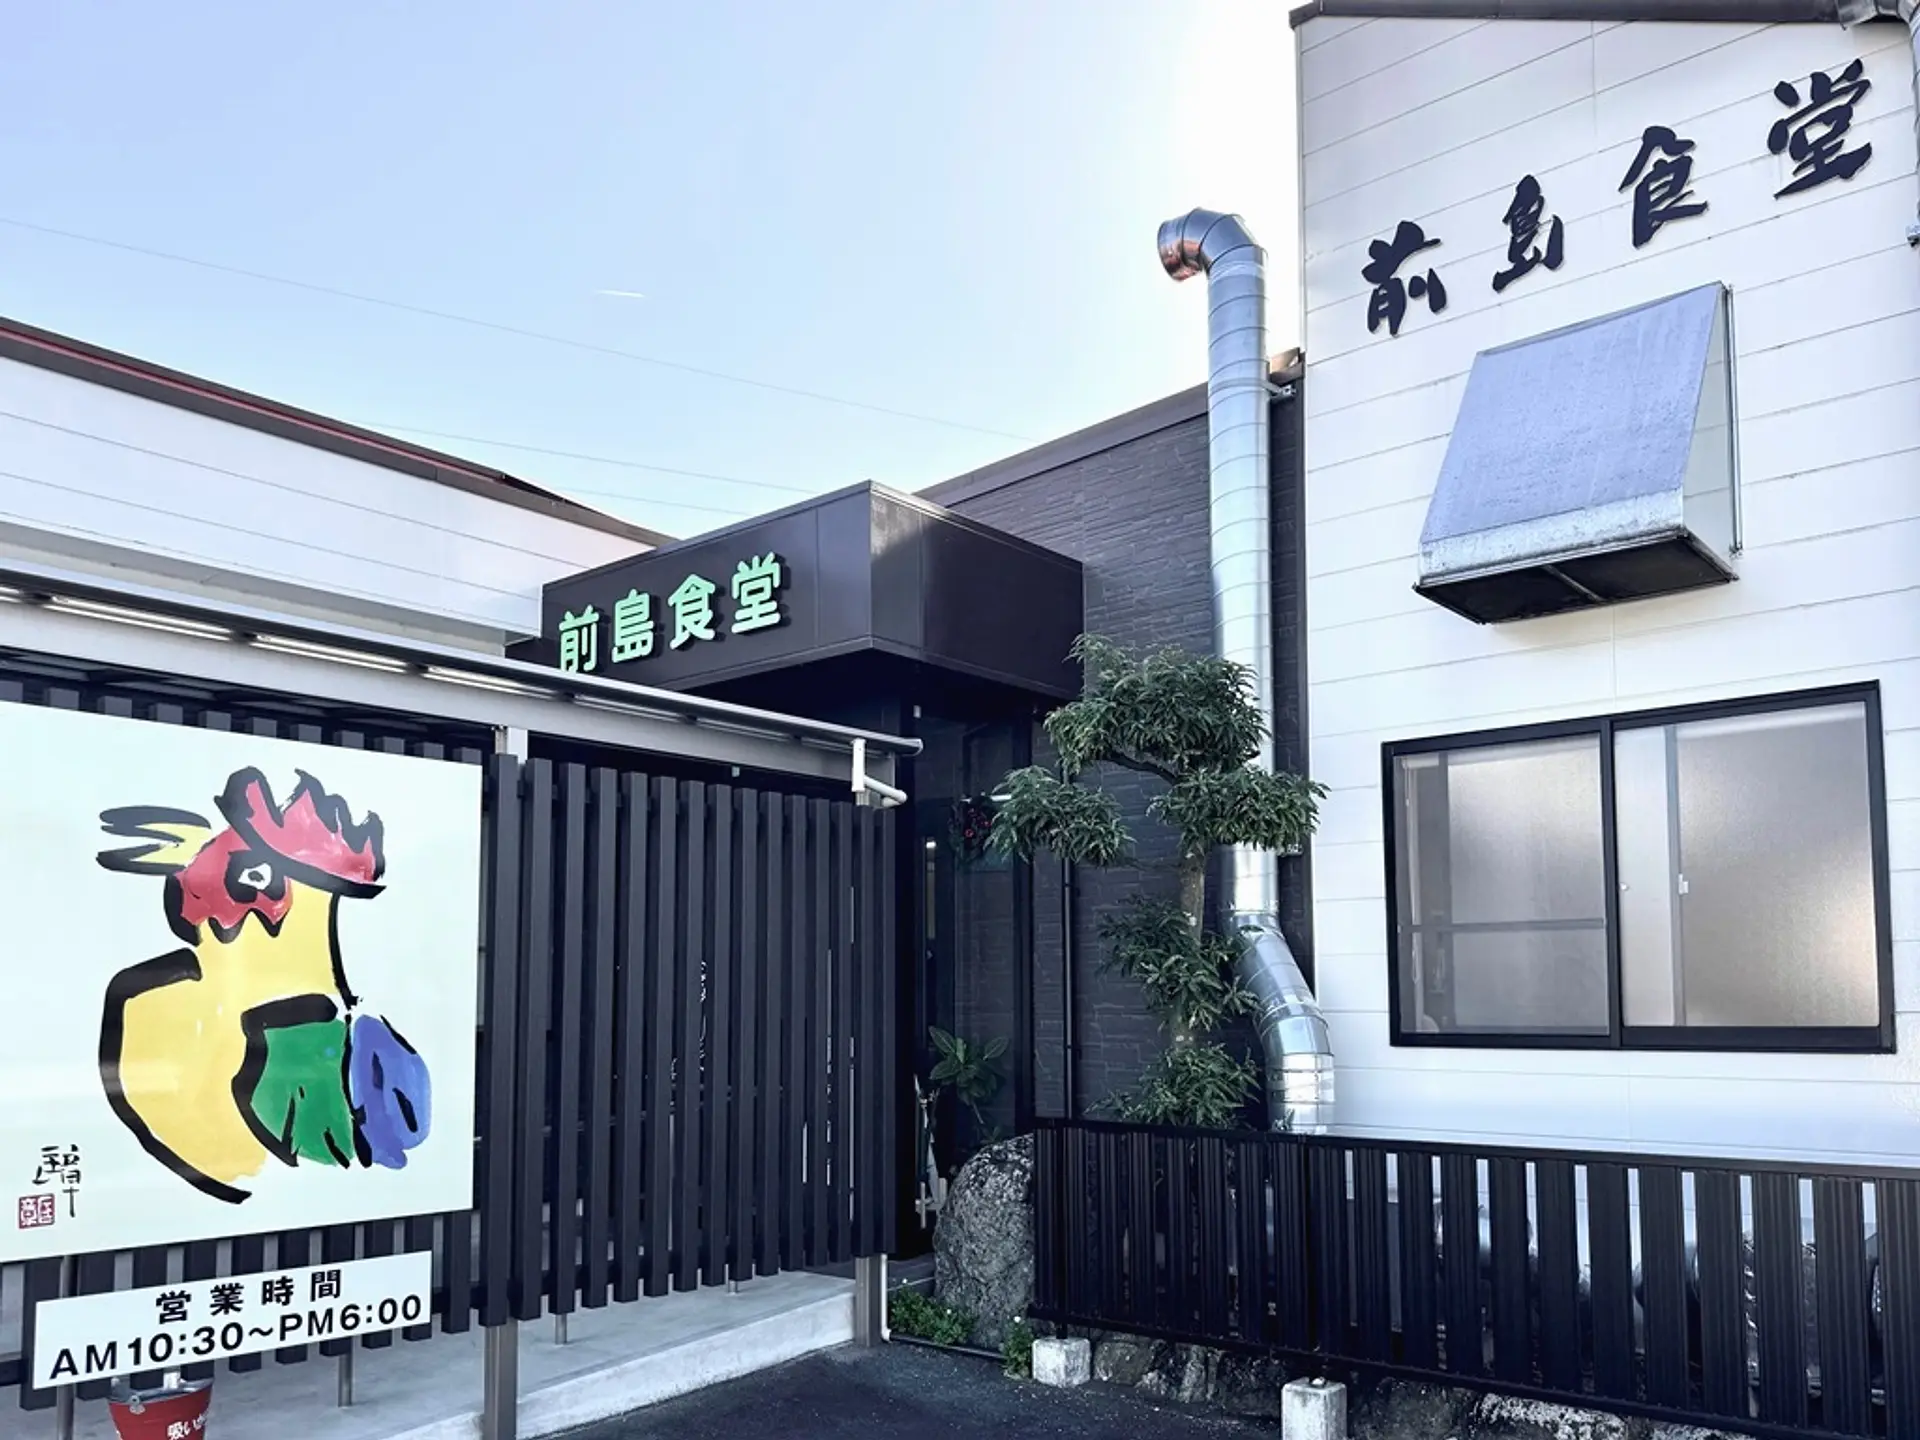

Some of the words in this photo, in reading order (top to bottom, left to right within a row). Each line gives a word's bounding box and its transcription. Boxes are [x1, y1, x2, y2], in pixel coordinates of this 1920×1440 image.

[1362, 58, 1872, 337] 前島食堂
[559, 551, 781, 674] 前島食堂
[156, 1269, 342, 1324] 営業時間
